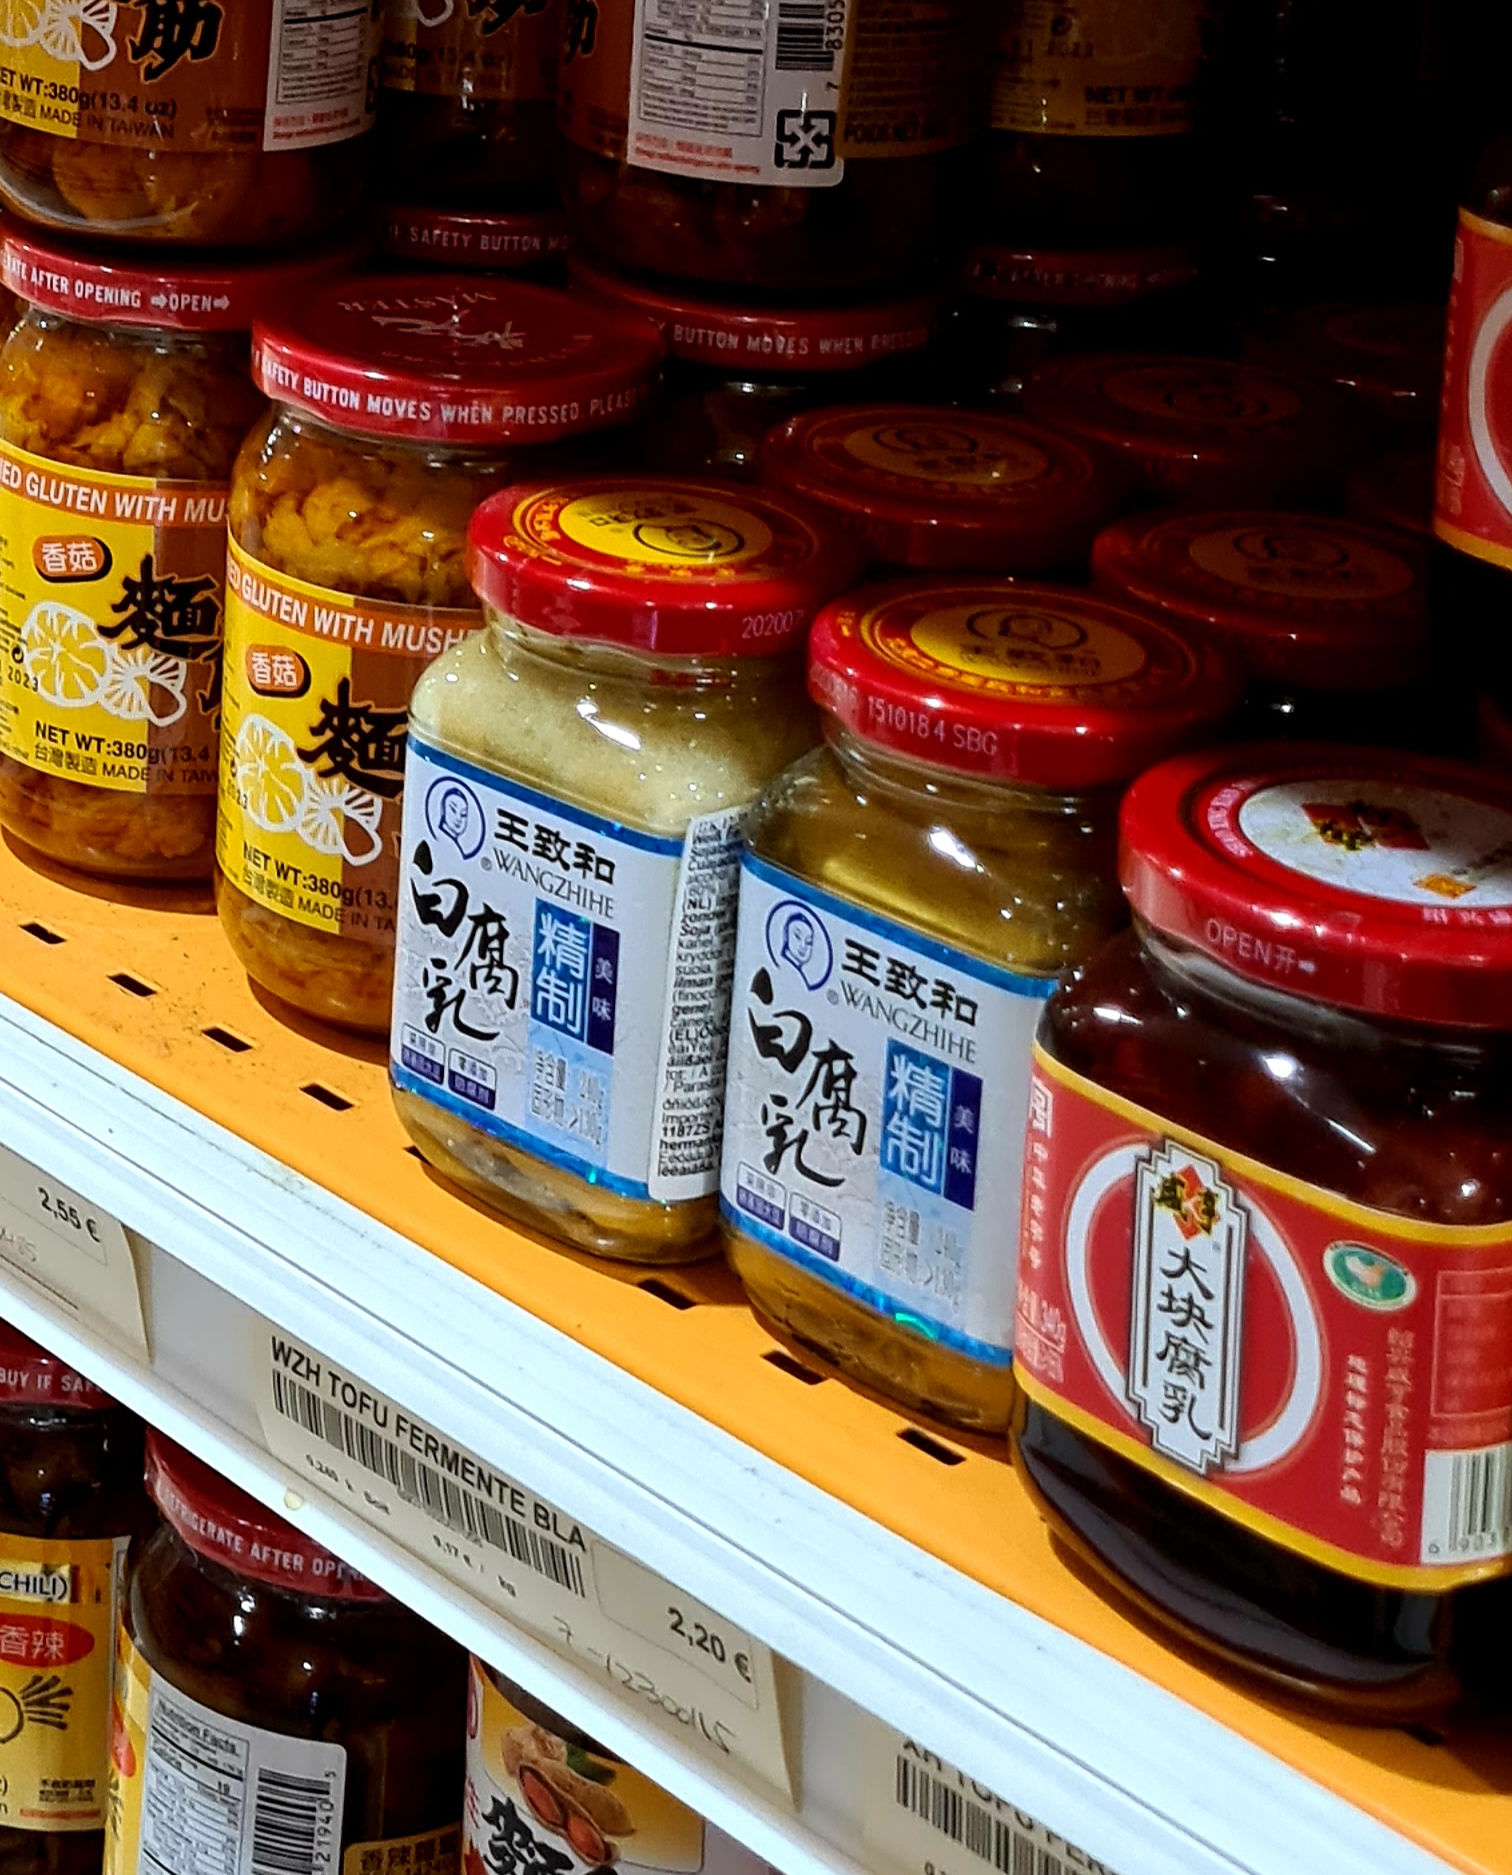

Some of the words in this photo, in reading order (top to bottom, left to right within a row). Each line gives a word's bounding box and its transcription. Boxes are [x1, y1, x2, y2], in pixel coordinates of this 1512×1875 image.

[30, 269, 70, 296] AFTER
[74, 281, 142, 309] OPENING
[168, 294, 214, 312] OPEN
[303, 377, 361, 411] BUTTON
[365, 396, 432, 421] MOVES
[439, 402, 493, 424] WHEN
[502, 403, 580, 425] PRESSED
[25, 470, 108, 520] GLUTEN
[113, 492, 177, 523] WITH
[41, 541, 100, 574] 香菇
[239, 576, 307, 626] GLUTEN
[311, 605, 375, 644] WITH
[249, 652, 298, 687] 香菇
[34, 720, 69, 746] NET
[102, 763, 150, 782] MADE
[242, 842, 271, 873] NET
[275, 858, 396, 904] WT:380g(13.
[493, 808, 616, 885] 王致和
[297, 897, 345, 923] MADE
[493, 846, 615, 919] WANGZHIHE
[1205, 917, 1272, 967] OPEN
[535, 912, 588, 1034] 精制
[841, 938, 979, 1027] 王致和
[840, 979, 977, 1064] WANGZHIHE
[886, 1053, 943, 1185] 精制
[38, 1187, 82, 1230] 2,55
[1156, 1246, 1217, 1442] 大块腐乳
[270, 1334, 322, 1388] WZH
[326, 1369, 389, 1430] TOFU
[393, 1413, 527, 1518] FERMENTE
[532, 1502, 588, 1553] BLA
[249, 1535, 306, 1573] AFTER
[666, 1606, 727, 1664] 2,20
